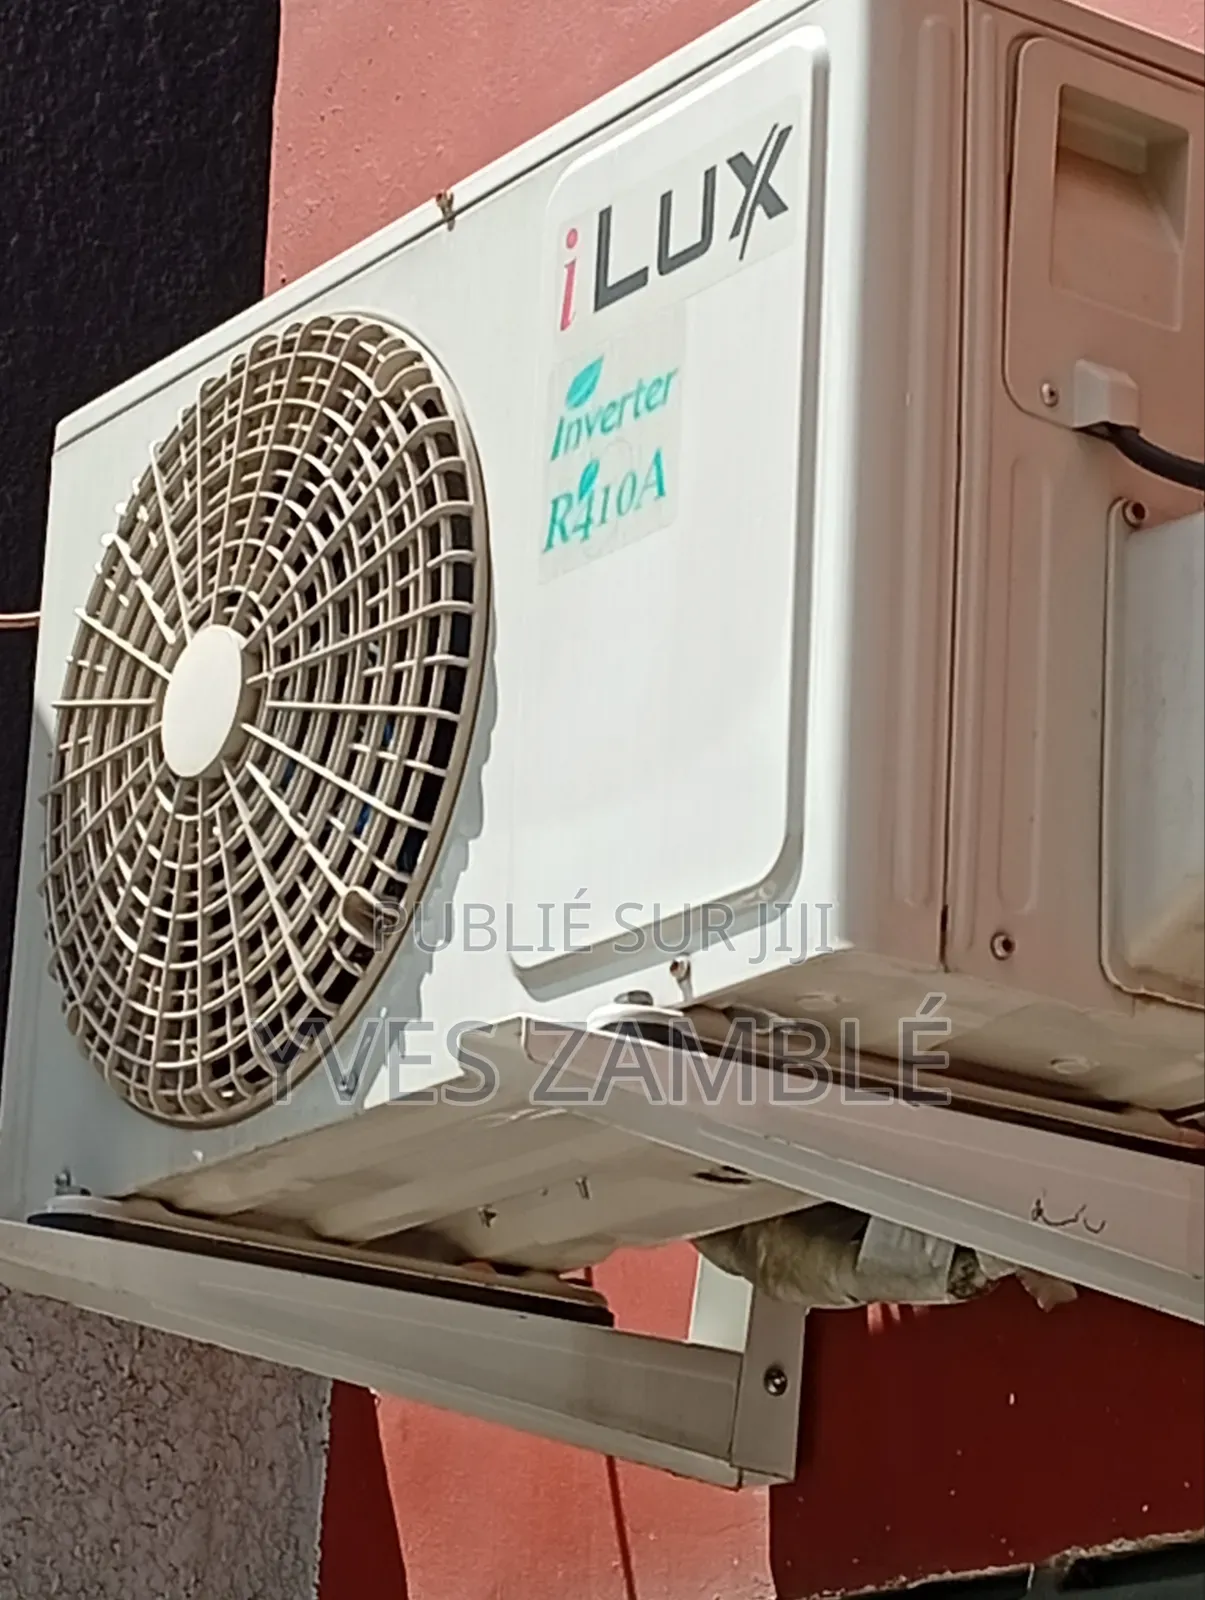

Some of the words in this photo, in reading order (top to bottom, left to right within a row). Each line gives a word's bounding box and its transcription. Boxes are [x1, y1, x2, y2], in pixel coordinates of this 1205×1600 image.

[560, 123, 793, 331] iLUX
[550, 367, 679, 462] Inverter
[542, 446, 666, 554] R410A
